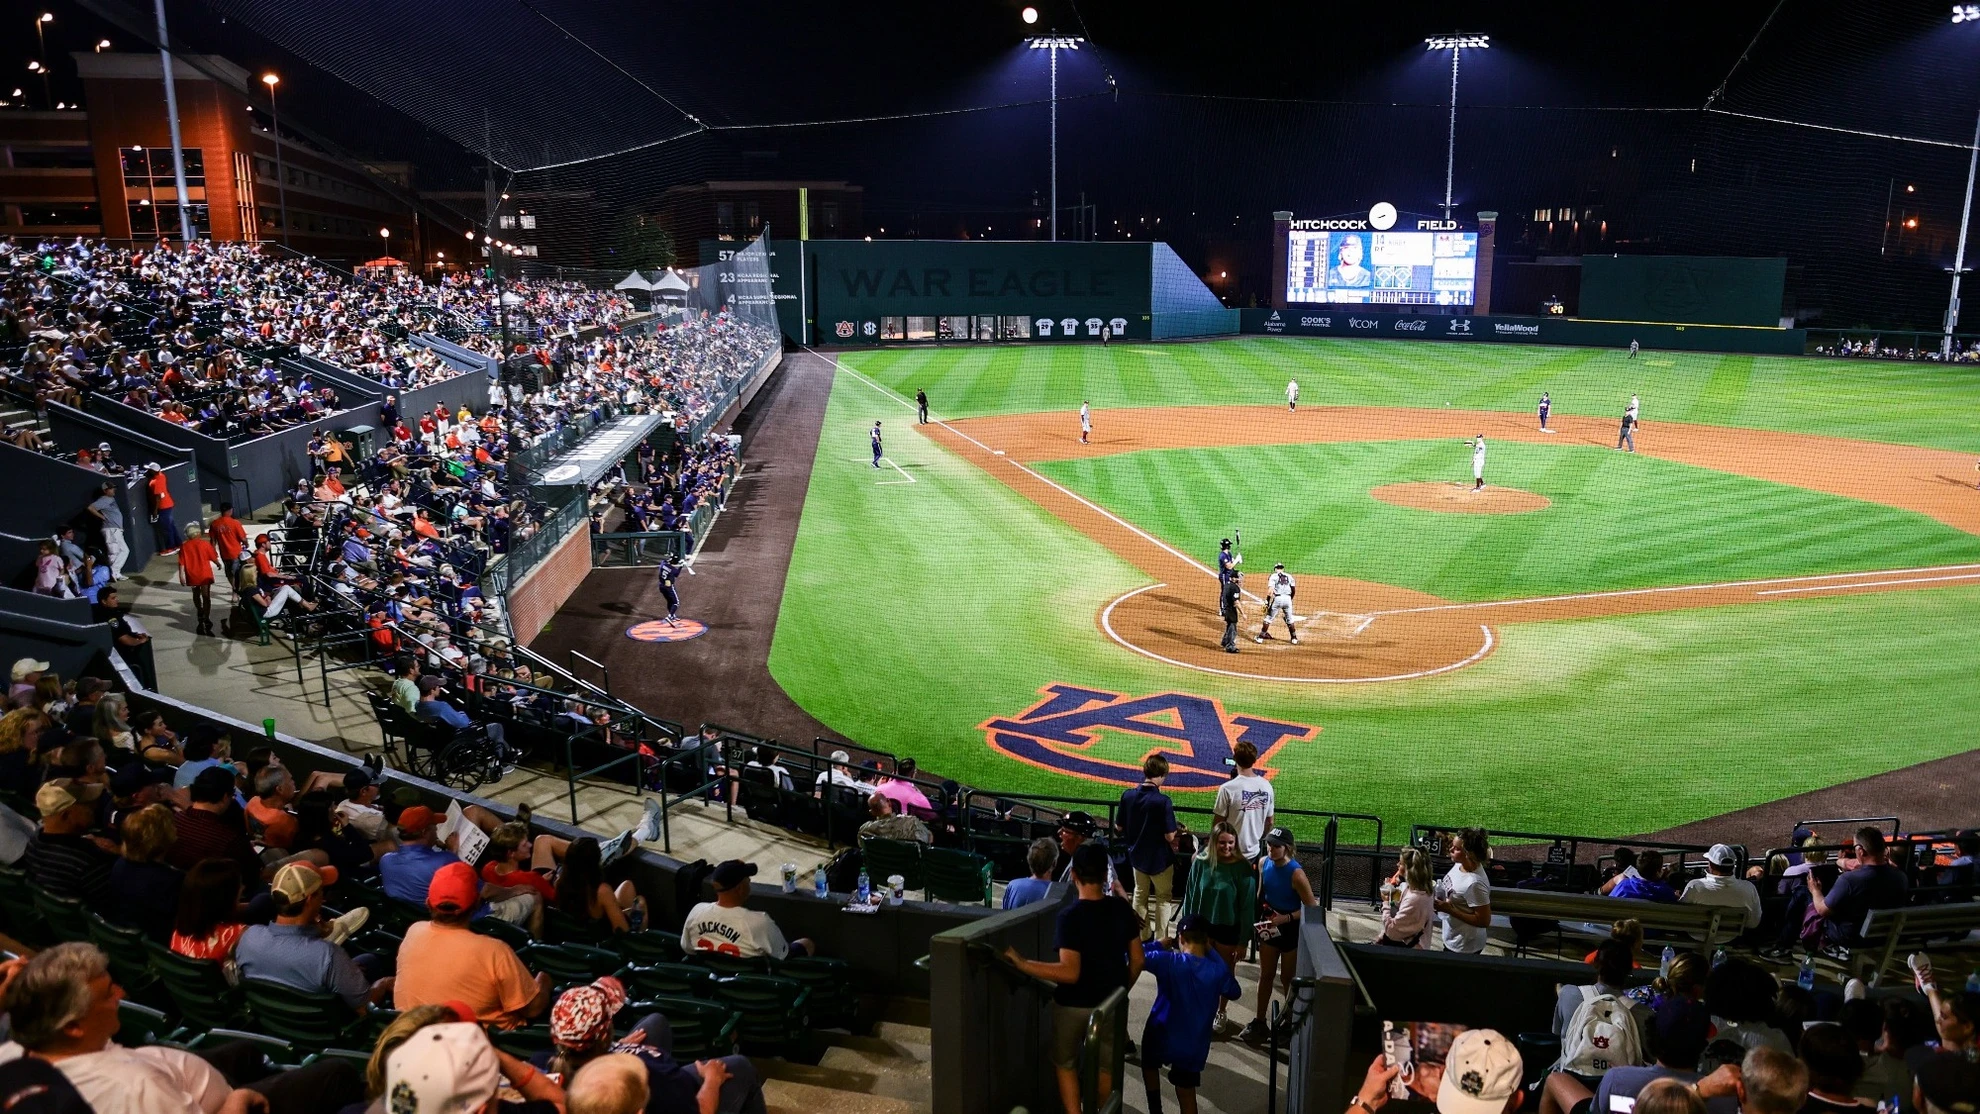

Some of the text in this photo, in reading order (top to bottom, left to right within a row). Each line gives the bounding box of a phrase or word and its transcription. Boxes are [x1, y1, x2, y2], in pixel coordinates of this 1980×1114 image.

[1290, 220, 1457, 230] HITCHCOCK FIELD
[719, 250, 735, 261] 57
[720, 272, 735, 283] 23
[840, 268, 1114, 297] WAR EAGLE
[727, 294, 736, 304] 4
[864, 322, 876, 335] SEC
[1349, 317, 1378, 329] VCOM
[1495, 324, 1538, 332] YellaWood
[662, 570, 669, 579] 5
[733, 749, 742, 758] 37
[1424, 840, 1438, 851] 35
[698, 921, 740, 943] JACKSON
[1593, 1059, 1608, 1069] 20
